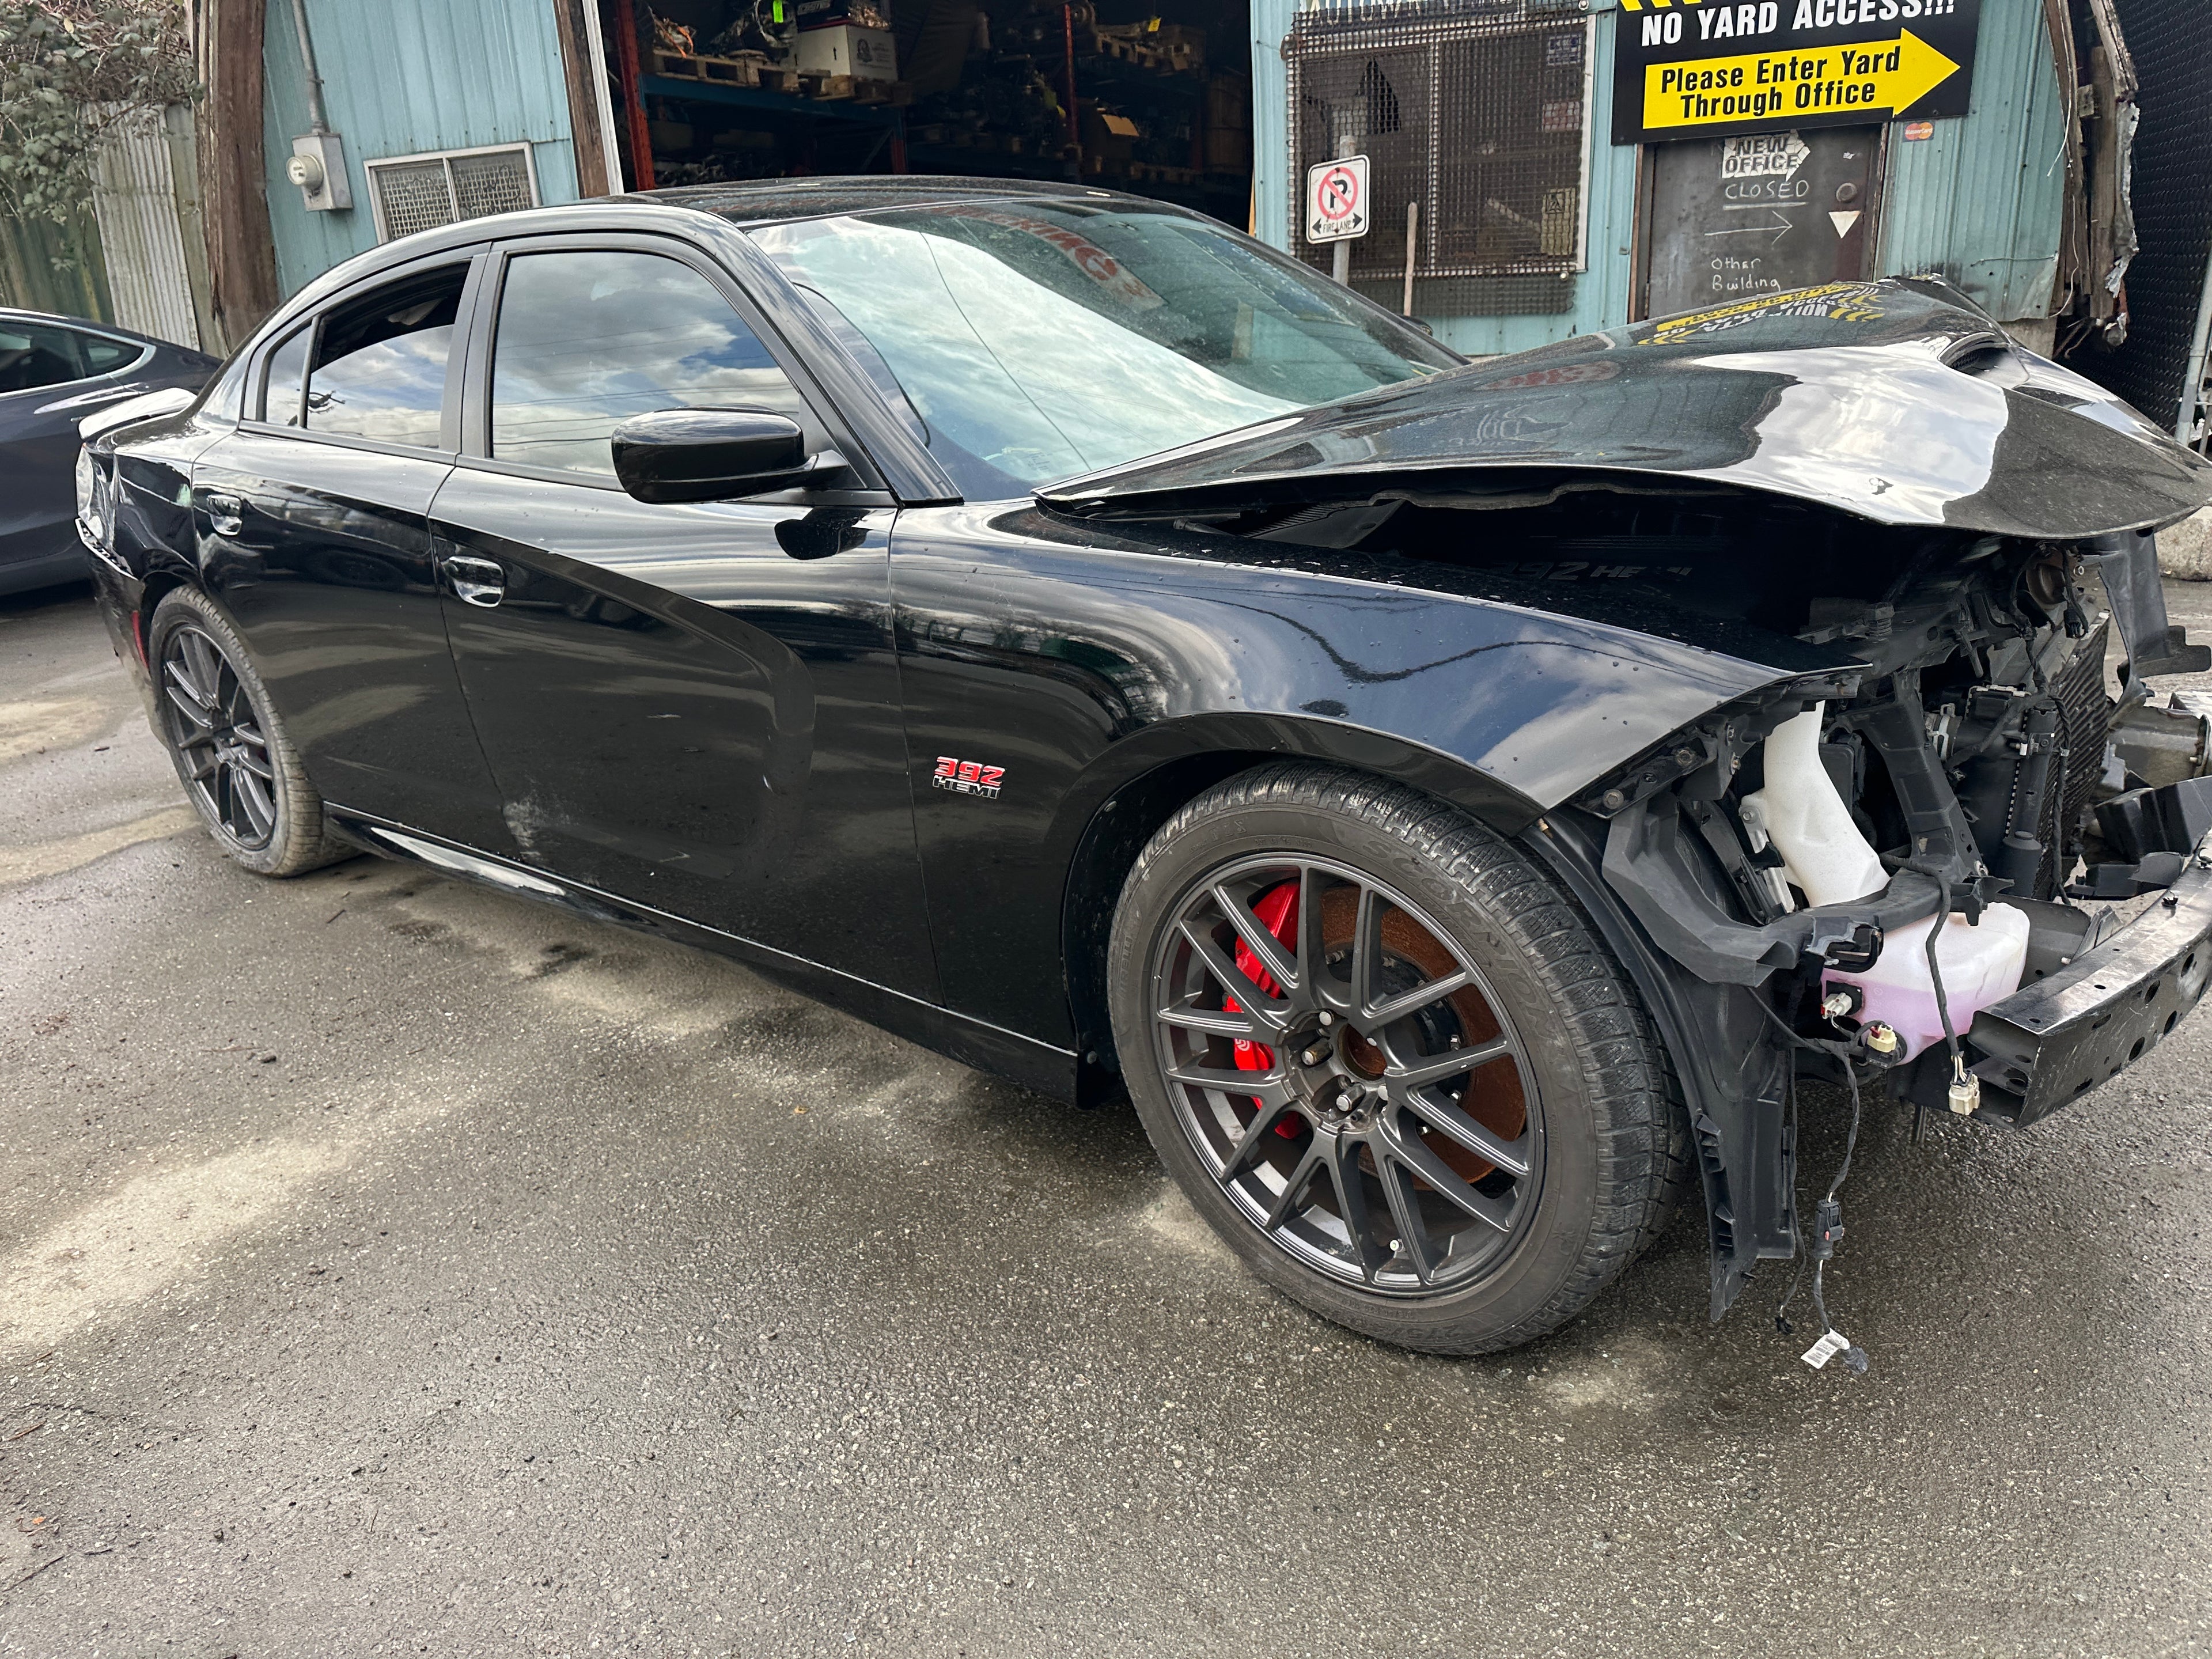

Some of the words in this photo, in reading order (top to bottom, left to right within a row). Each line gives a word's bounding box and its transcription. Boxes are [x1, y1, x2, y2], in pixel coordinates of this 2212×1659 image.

[1641, 13, 1682, 47] NO
[1697, 3, 1778, 40] YARD
[1661, 66, 1743, 93] Please
[1756, 53, 1827, 84] Enter
[1841, 46, 1901, 75] Yard
[1680, 84, 1782, 118] Through
[1795, 81, 1876, 108] Office
[1736, 135, 1787, 156] NEW
[1725, 153, 1799, 173] OFFICE
[1725, 180, 1809, 199] CLOSED
[1323, 222, 1335, 233] FIRE
[1713, 274, 1781, 293] Building
[1589, 565, 1693, 578] HEI
[934, 756, 1006, 787] 392
[932, 775, 1001, 800] HEMI
